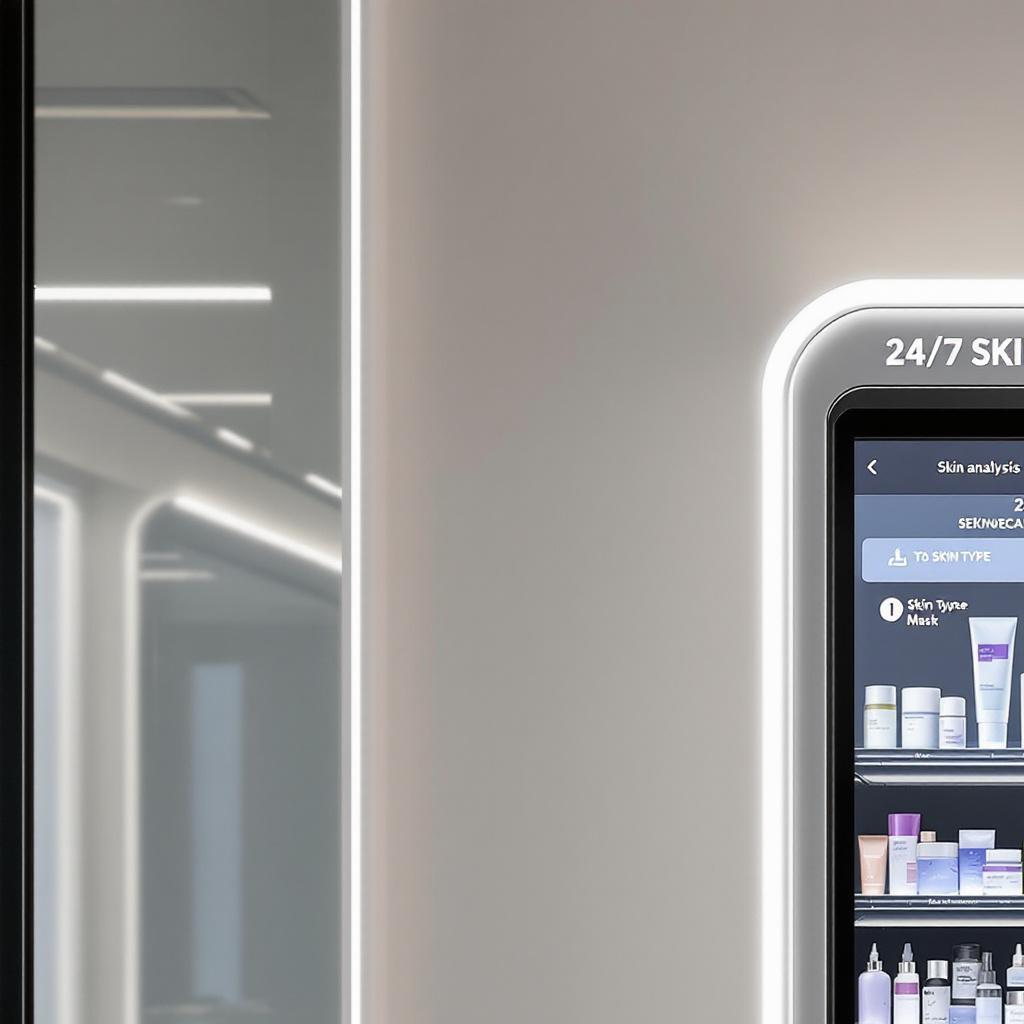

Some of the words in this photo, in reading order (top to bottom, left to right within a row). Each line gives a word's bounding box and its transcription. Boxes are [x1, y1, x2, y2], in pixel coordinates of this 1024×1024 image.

[885, 336, 963, 368] 24/7
[937, 460, 964, 474] Skin
[967, 460, 1021, 476] analysis
[961, 551, 992, 562] TYPE
